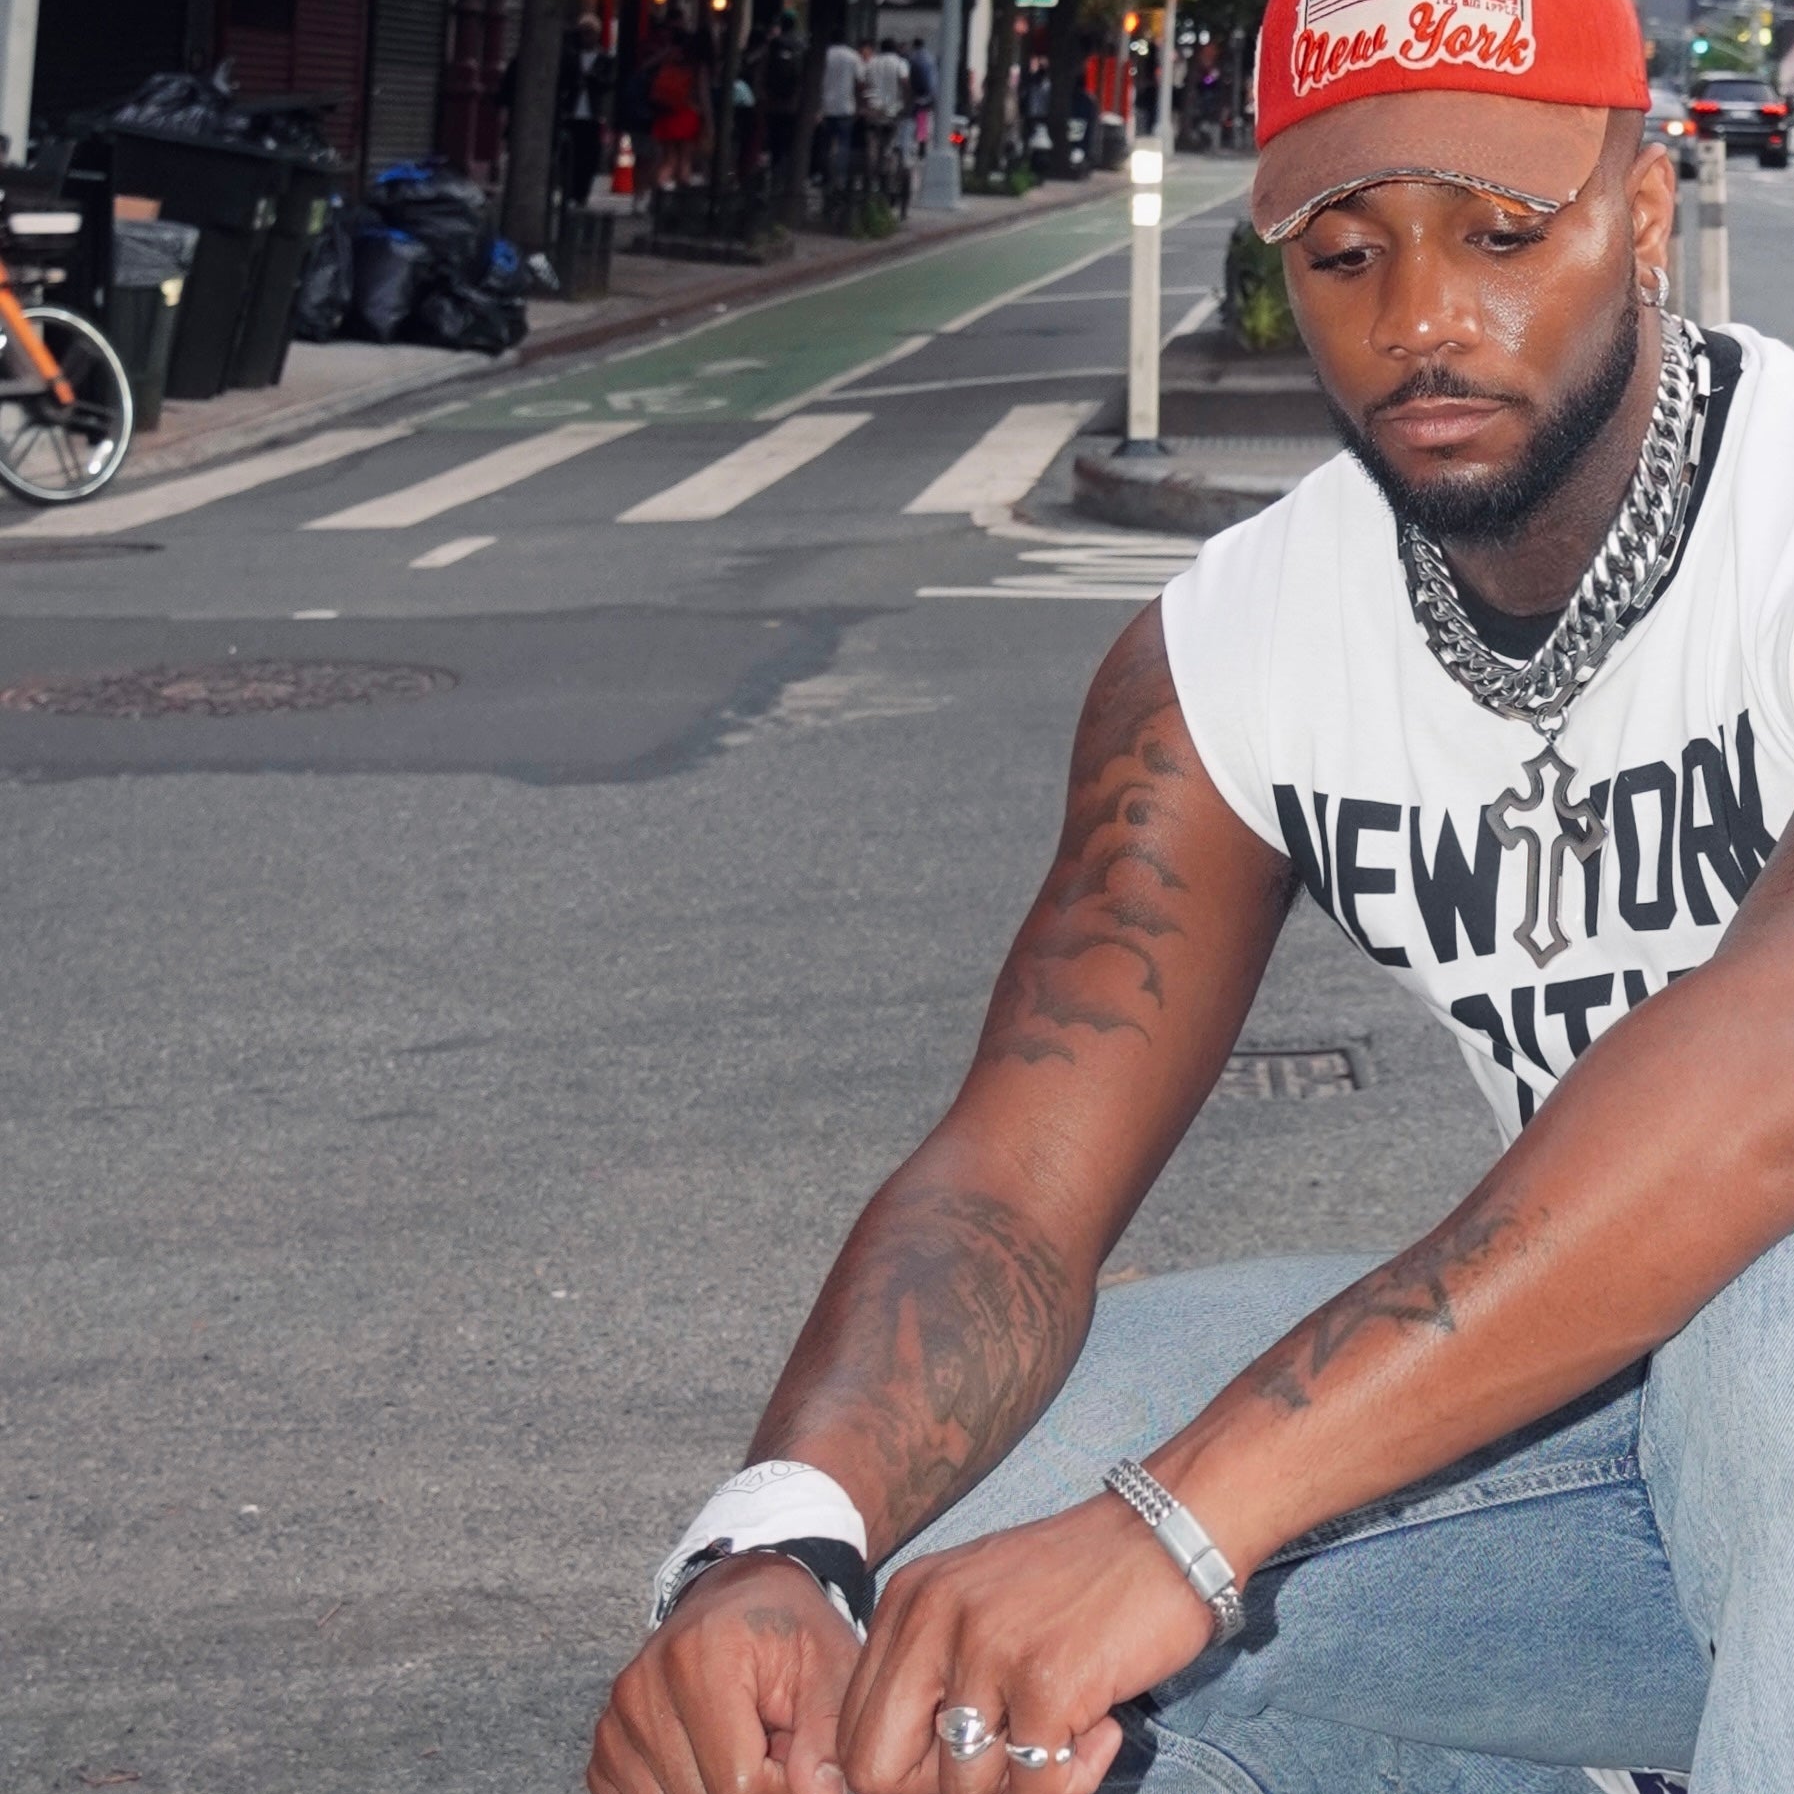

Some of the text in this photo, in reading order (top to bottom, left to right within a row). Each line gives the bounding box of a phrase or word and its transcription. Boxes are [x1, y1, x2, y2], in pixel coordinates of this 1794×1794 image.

[1295, 2, 1530, 89] New York
[1272, 708, 1778, 969] NEW YORK
